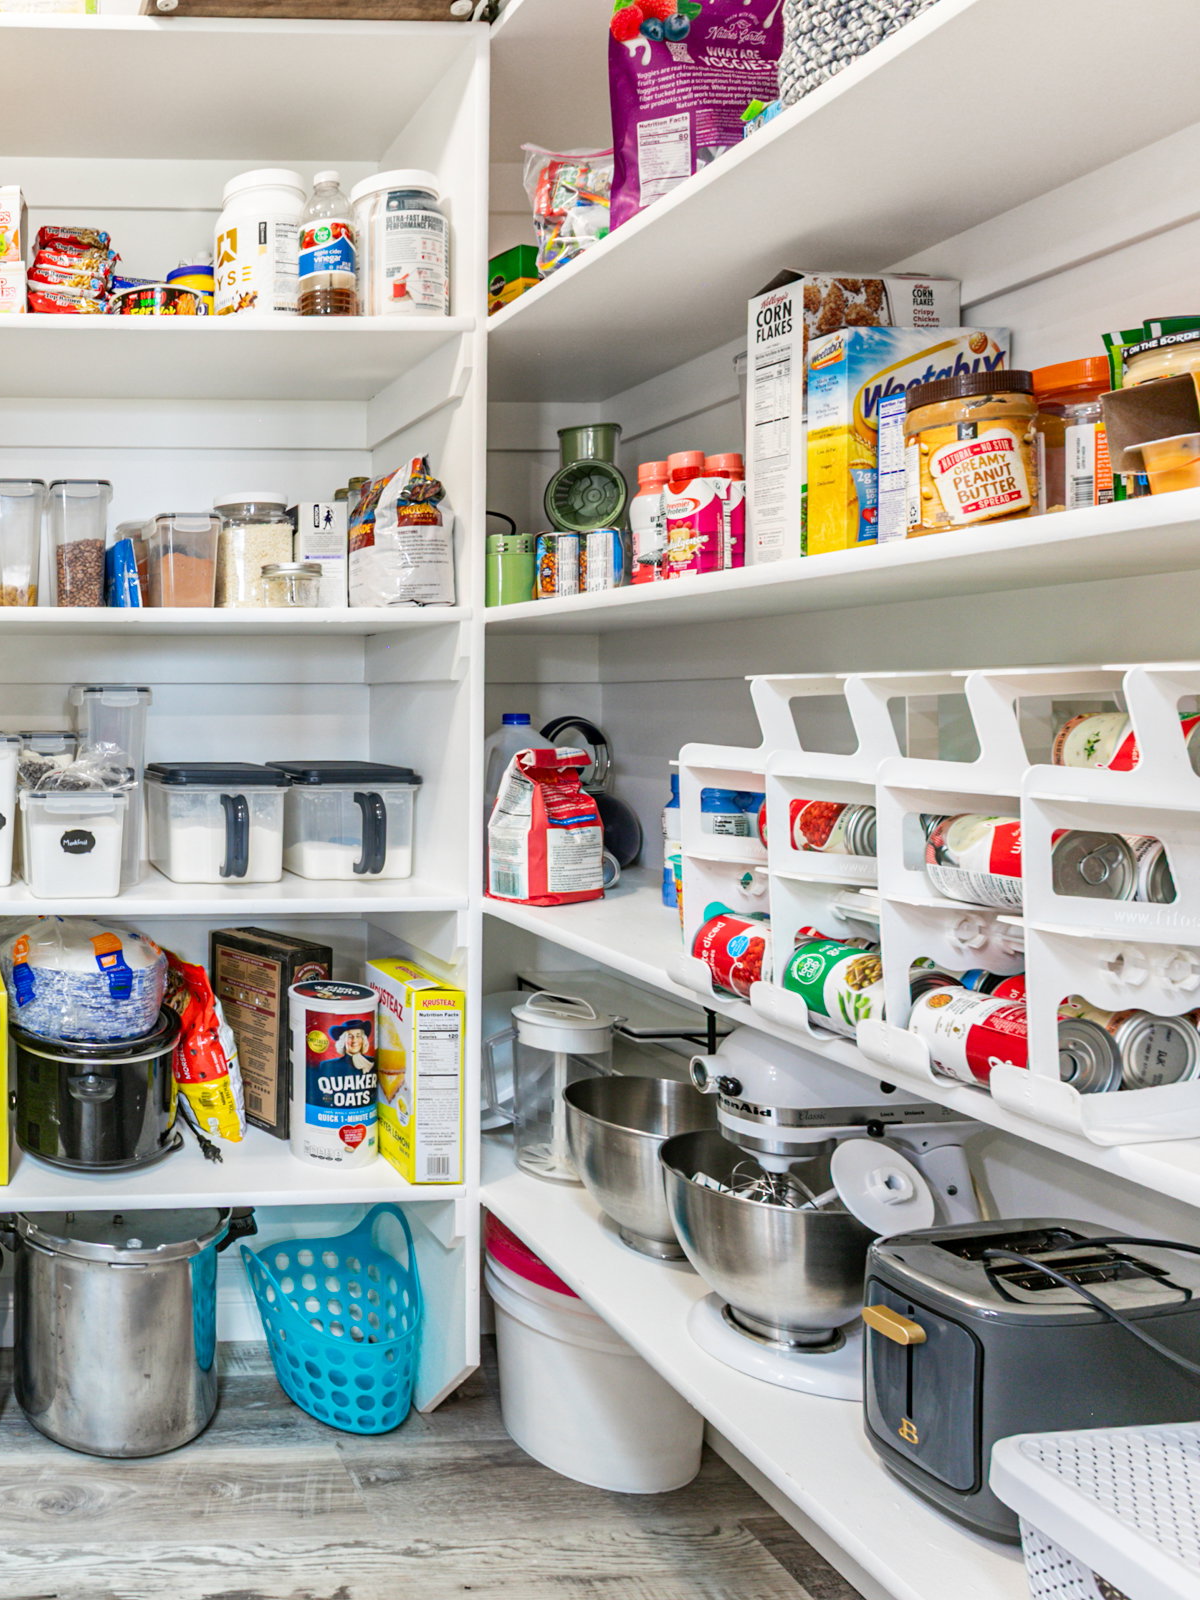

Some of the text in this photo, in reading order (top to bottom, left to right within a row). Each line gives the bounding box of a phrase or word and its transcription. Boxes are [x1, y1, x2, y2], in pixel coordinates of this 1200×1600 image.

[738, 29, 766, 45] Garden
[706, 46, 761, 59] WHAT ARE
[637, 70, 659, 80] Yoggies
[637, 73, 676, 87] fruity-sweet
[636, 86, 659, 96] Yoggies
[655, 88, 675, 98] tucked
[650, 96, 682, 110] probiotics
[682, 92, 693, 100] will
[676, 98, 703, 109] Nature's
[640, 116, 688, 129] Nutrition Facts
[678, 133, 688, 141] 80
[386, 214, 420, 224] ULTRA-FAST
[48, 228, 83, 237] Top Ramen
[386, 222, 426, 231] PERFORMANCE
[56, 243, 69, 252] Top
[314, 248, 329, 257] apple
[314, 254, 342, 264] vinegar
[37, 269, 49, 278] Top
[217, 266, 252, 291] YSE
[45, 293, 81, 304] Top Ramen
[912, 289, 933, 298] CORN
[760, 292, 789, 309] Kellogg's
[912, 298, 934, 306] FLAKES
[756, 300, 792, 328] CORN
[913, 308, 934, 316] Crispy
[756, 318, 792, 344] FLAKES
[1129, 330, 1200, 354] ON THE BORDE
[812, 338, 844, 363] Weetabix
[941, 439, 1010, 468] NATURAL NO STIR
[954, 453, 1006, 476] CREAMY
[856, 471, 872, 484] 2g
[953, 462, 1012, 490] PEANUT
[958, 476, 1016, 504] BUTTER
[666, 502, 690, 510] Premier
[978, 496, 1010, 508] SPREAD
[704, 922, 726, 949] diced
[799, 958, 814, 976] food
[806, 960, 821, 978] club
[422, 998, 456, 1008] KRUSTEAZ
[318, 1074, 378, 1094] QUAKER
[334, 1091, 370, 1107] OATS
[719, 1093, 772, 1118] enAid
[318, 1113, 368, 1123] QUICK 1-MINUTE
[798, 1110, 826, 1122] Classic
[380, 1117, 410, 1149] EYER LEMON
[898, 1418, 919, 1444] B
